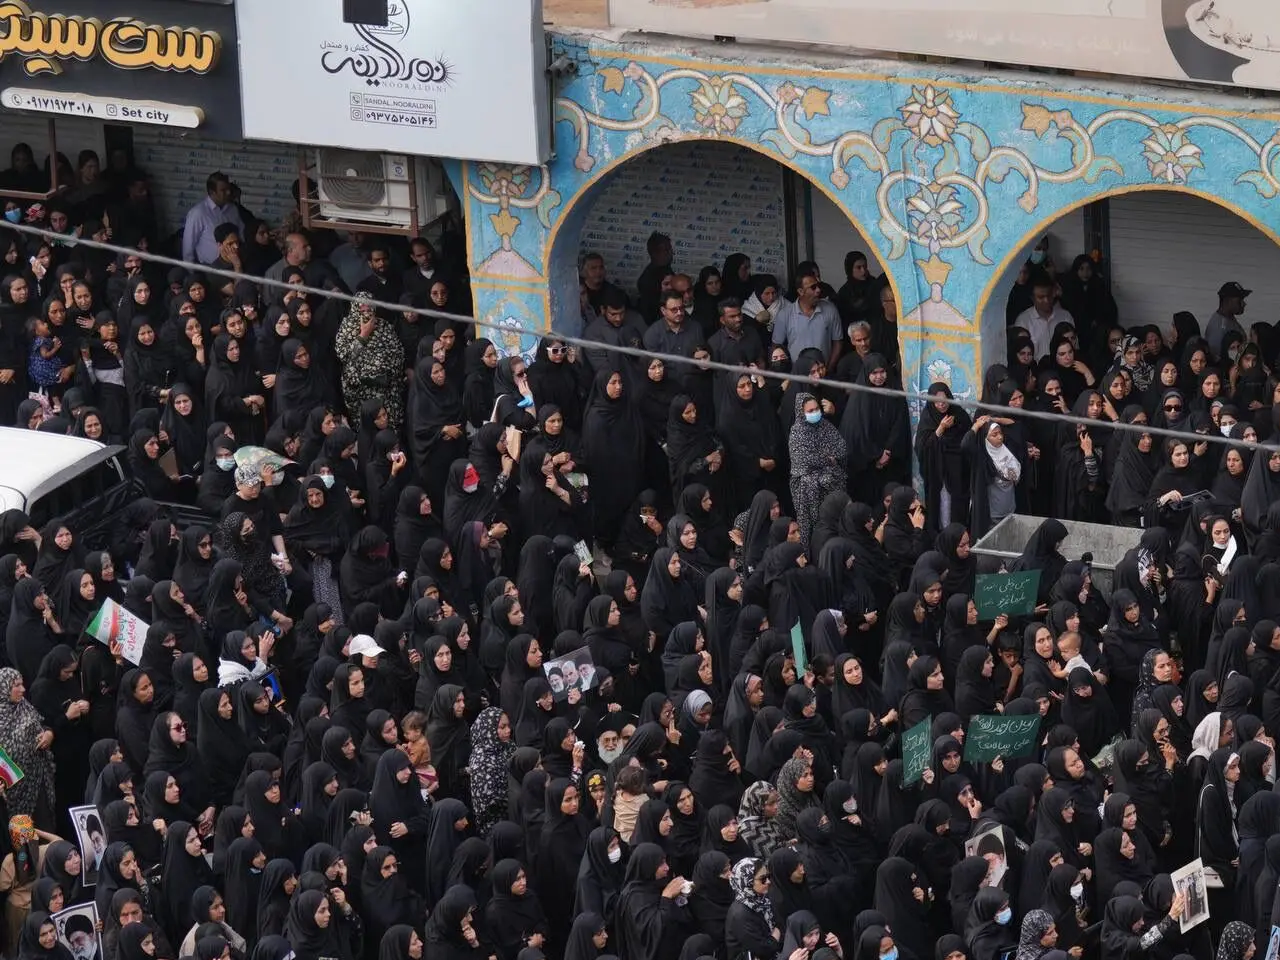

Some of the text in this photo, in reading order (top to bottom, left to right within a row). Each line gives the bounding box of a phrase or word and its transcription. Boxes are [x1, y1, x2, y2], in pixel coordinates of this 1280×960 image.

[0, 4, 98, 77] سیت
[121, 107, 169, 122] Set city
